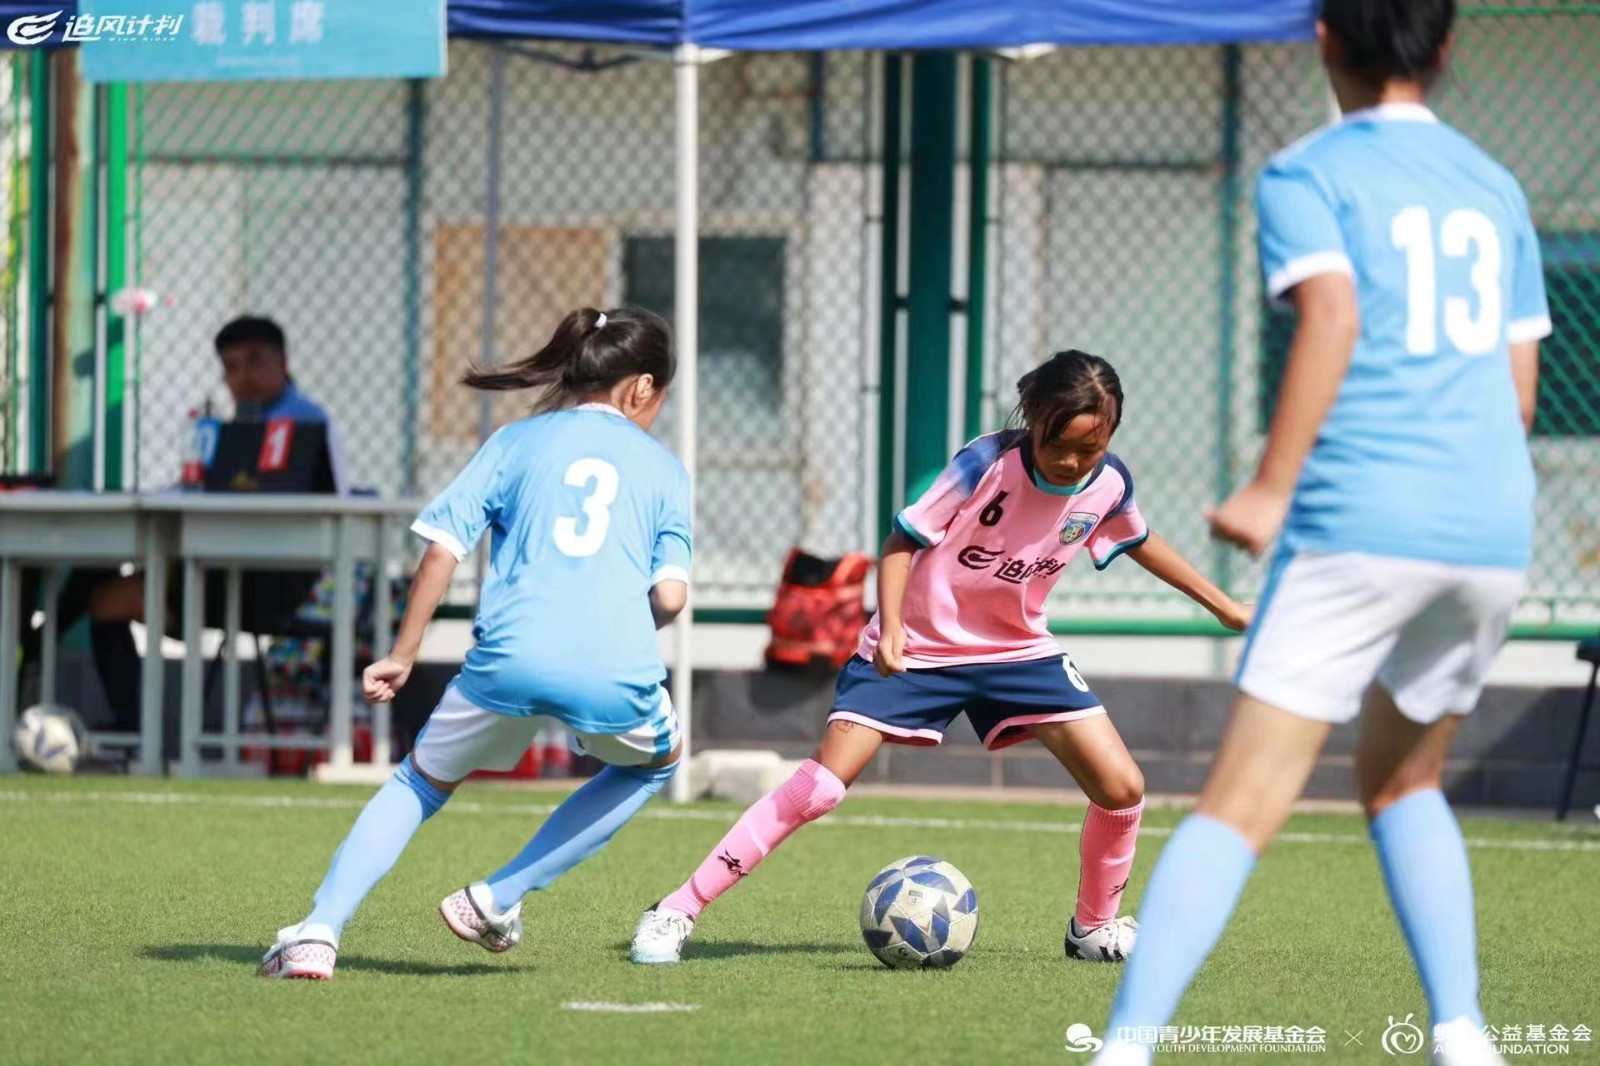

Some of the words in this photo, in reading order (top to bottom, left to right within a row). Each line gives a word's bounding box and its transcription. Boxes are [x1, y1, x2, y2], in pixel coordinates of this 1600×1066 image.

[1391, 204, 1501, 355] 13
[267, 426, 287, 467] 1
[553, 457, 619, 557] 3
[979, 490, 1009, 527] 6
